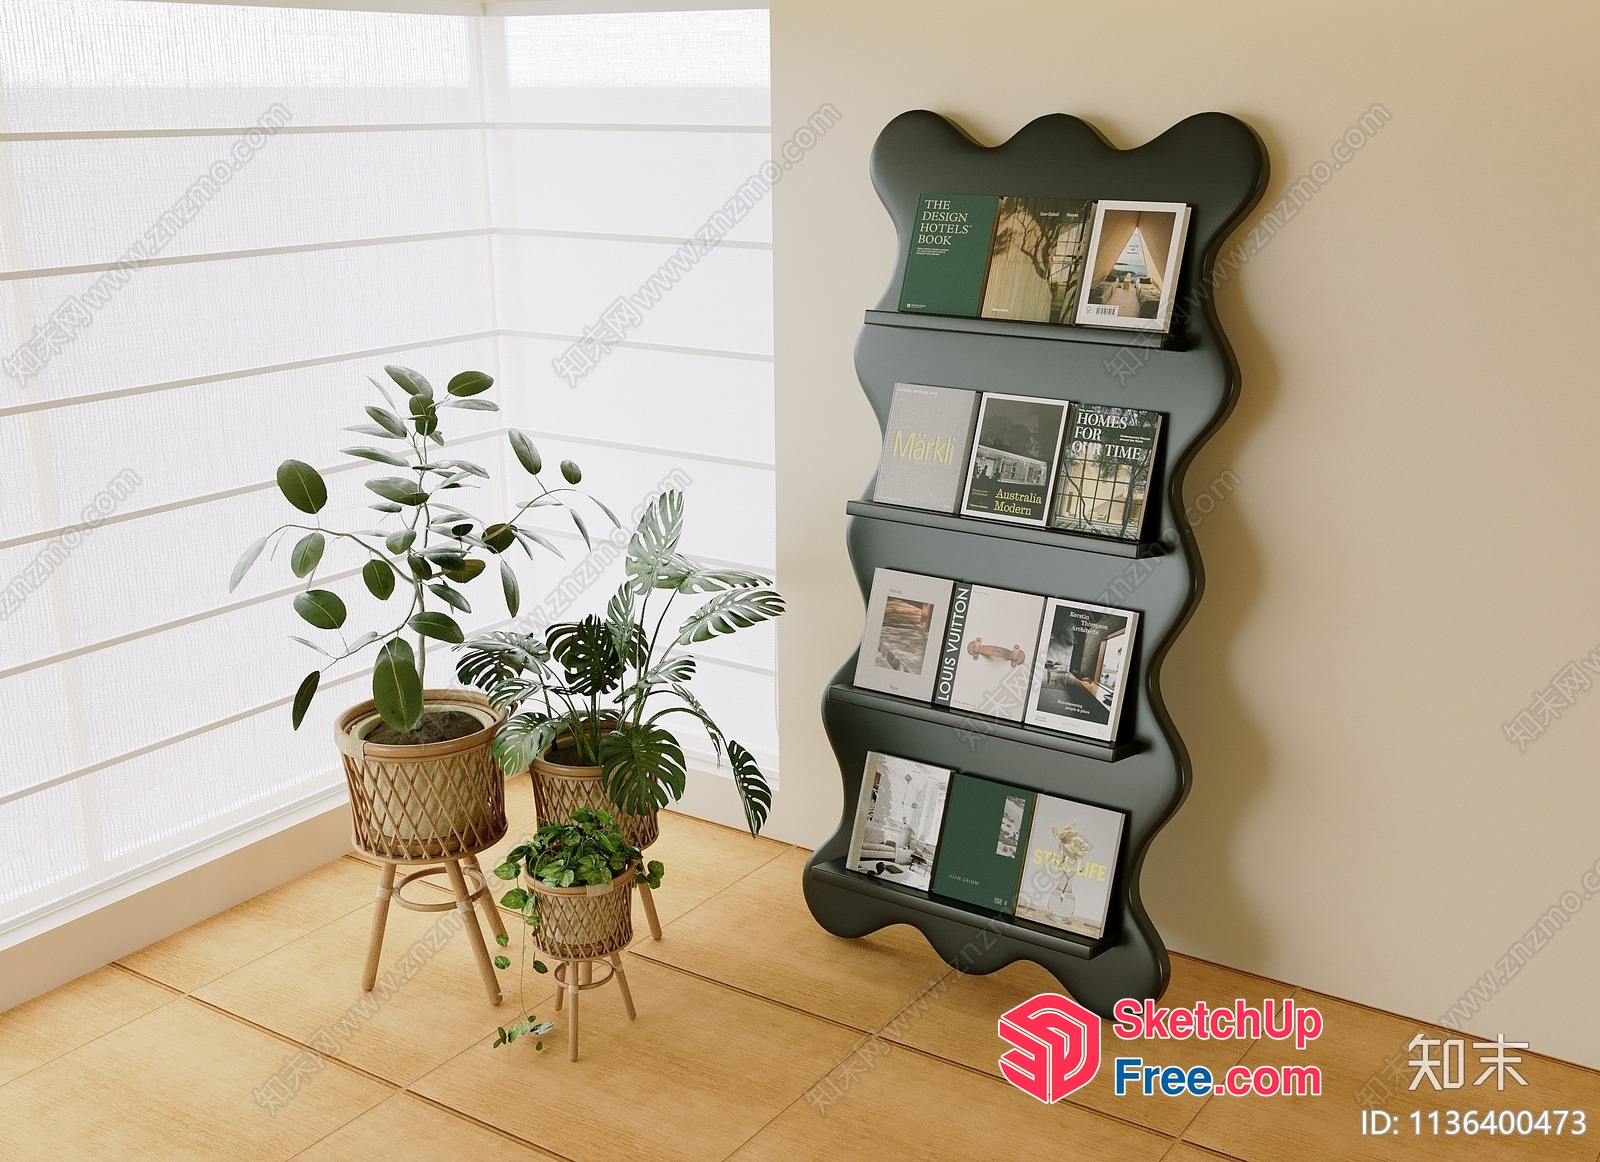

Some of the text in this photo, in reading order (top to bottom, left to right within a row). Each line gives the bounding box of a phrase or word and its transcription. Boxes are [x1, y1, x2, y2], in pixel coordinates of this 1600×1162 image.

[925, 199, 950, 210] THE
[922, 211, 968, 222] DESIGN
[918, 234, 952, 245] BOOK
[1077, 412, 1128, 429] HOMES
[1074, 426, 1102, 441] FOR
[892, 430, 955, 464] Märkli
[1072, 440, 1142, 460] OUR TIME
[995, 488, 1042, 504] Australia
[993, 500, 1032, 516] Modern
[1069, 611, 1090, 620] Kerstin
[1071, 626, 1099, 635] Architects
[1081, 620, 1109, 630] Thompson
[937, 587, 970, 701] LOUIS VUITTON
[1075, 858, 1107, 882] LIFE
[948, 873, 979, 886] JUAN GRIMM
